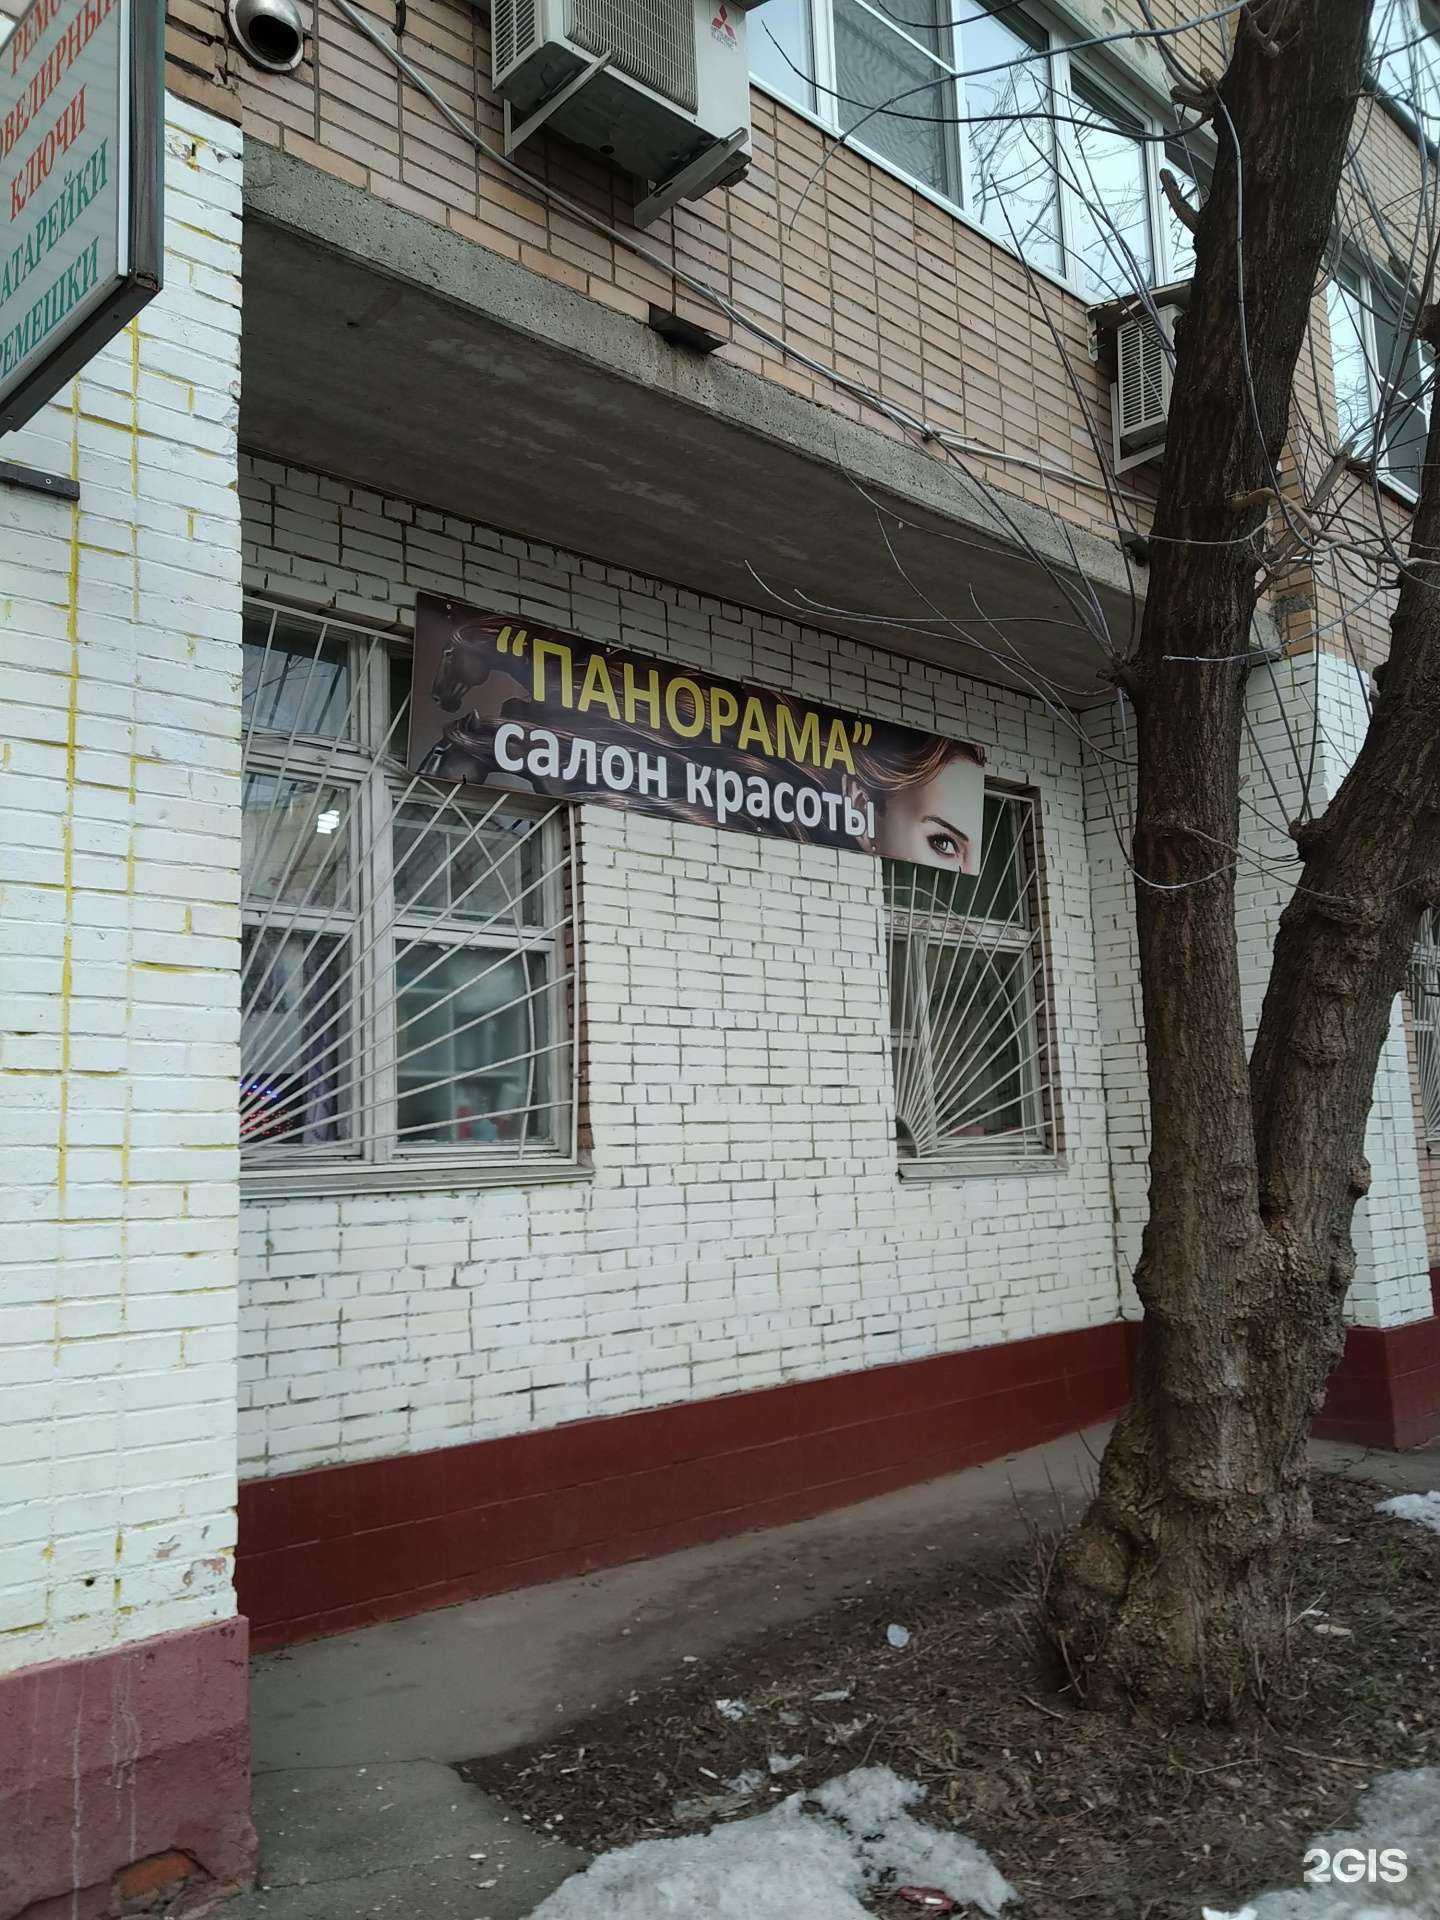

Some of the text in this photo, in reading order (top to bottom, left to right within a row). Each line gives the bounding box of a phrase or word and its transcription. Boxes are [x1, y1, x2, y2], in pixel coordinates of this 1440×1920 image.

[0, 0, 112, 160] ВЕЛИРНЫ
[0, 137, 108, 307] АТАРЕЙКИ
[10, 83, 87, 222] КЛЮЧИ
[0, 235, 99, 379] ЕМЕШКИ
[494, 722, 876, 839] салон красоты
